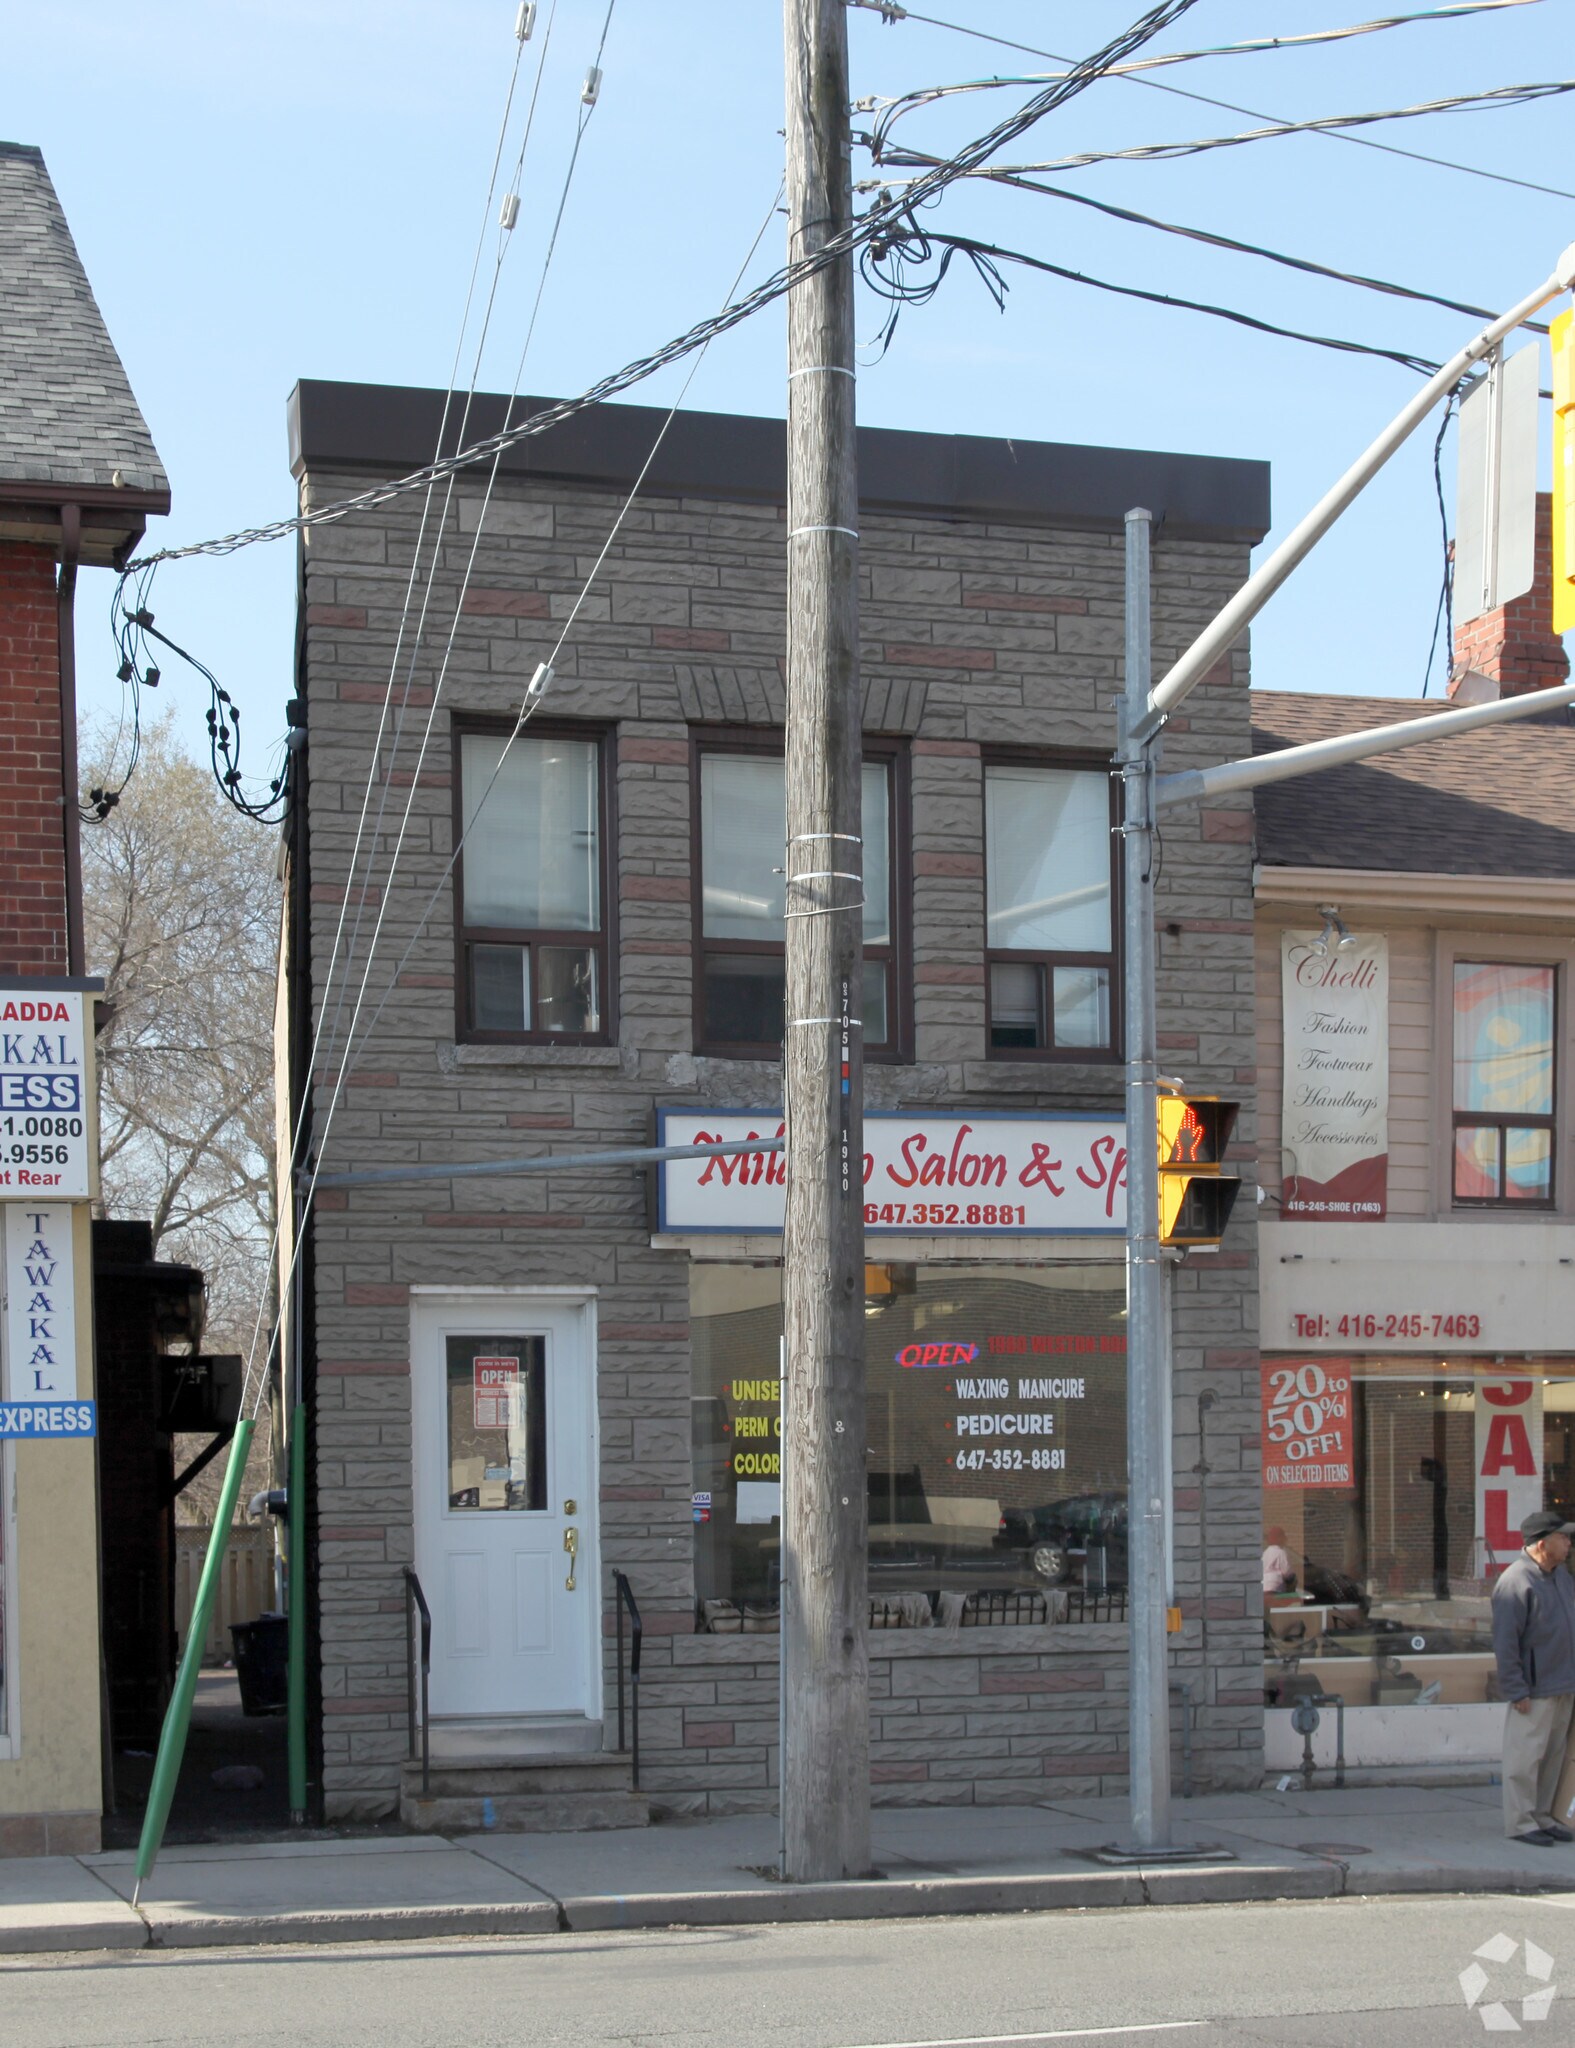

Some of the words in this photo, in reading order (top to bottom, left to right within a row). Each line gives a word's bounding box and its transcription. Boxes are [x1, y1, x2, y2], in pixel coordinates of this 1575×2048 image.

[1288, 945, 1378, 989] Chelli
[0, 1001, 71, 1022] ADDA
[1302, 1011, 1368, 1036] Fashion
[1297, 1048, 1374, 1073] Footwear
[0, 1075, 77, 1109] ESS
[1293, 1083, 1379, 1117] Handbags
[0, 1116, 83, 1138] 1.0080
[1291, 1120, 1379, 1146] Accessories
[0, 1144, 69, 1165] .9556
[18, 1169, 62, 1186] Rear
[886, 1124, 1008, 1188] Salon
[1018, 1142, 1065, 1198] &
[1076, 1135, 1128, 1218] Sp
[863, 1203, 1026, 1225] 647.352.8881
[1288, 1200, 1350, 1213] 416-245-SHOE
[1352, 1201, 1381, 1214] (7463)
[23, 1213, 59, 1392] TAWAKAL
[1294, 1314, 1330, 1338] Tel:
[1338, 1314, 1480, 1338] 416-245-7463
[899, 1343, 976, 1369] OPEN
[481, 1369, 512, 1385] OPEN
[956, 1378, 1009, 1399] WAXING
[1019, 1378, 1085, 1399] MANICURE
[1269, 1364, 1326, 1405] 20
[1327, 1378, 1348, 1393] to
[732, 1380, 781, 1401] UNISE
[0, 1406, 92, 1432] XPRESS
[735, 1417, 768, 1437] PERM
[956, 1414, 1054, 1436] PEDICURE
[1286, 1431, 1343, 1460] OFF!
[956, 1449, 1065, 1470] 647-352-8881
[1266, 1466, 1279, 1484] ON
[1281, 1465, 1321, 1483] SELECTED
[1324, 1463, 1349, 1482] ITEMS
